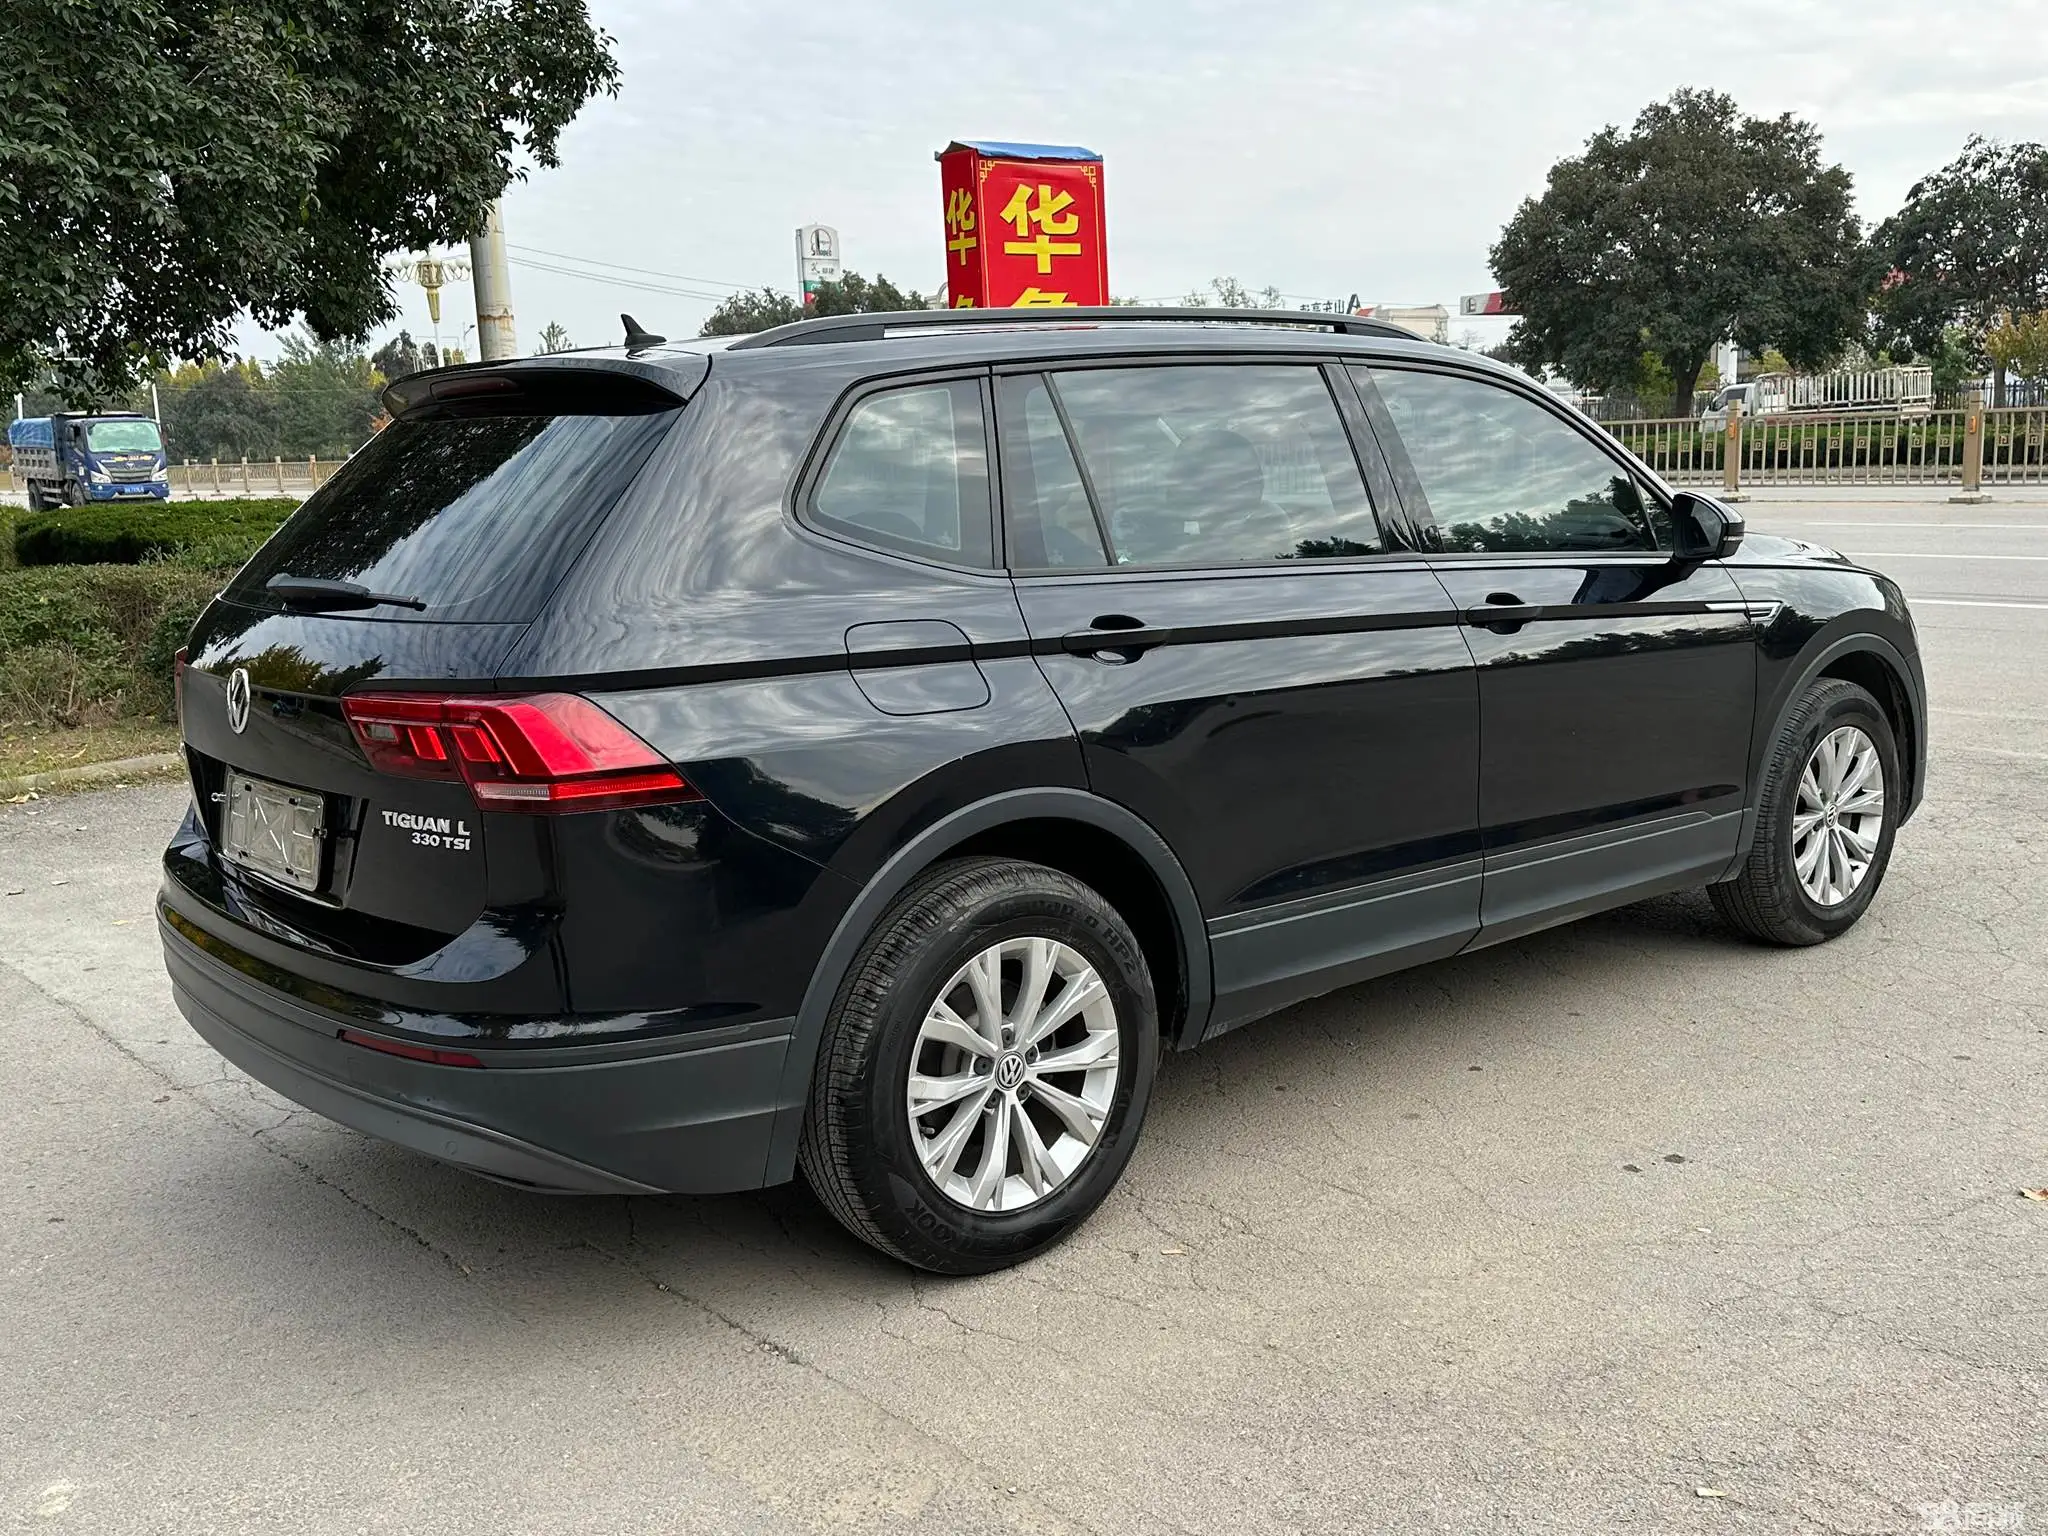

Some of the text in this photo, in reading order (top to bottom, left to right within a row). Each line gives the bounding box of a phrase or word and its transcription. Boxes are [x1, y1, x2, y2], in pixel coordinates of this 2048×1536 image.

[946, 187, 978, 308] 华
[999, 183, 1083, 307] 华
[381, 810, 471, 836] TIGUAN L
[411, 831, 471, 851] 330 TSI
